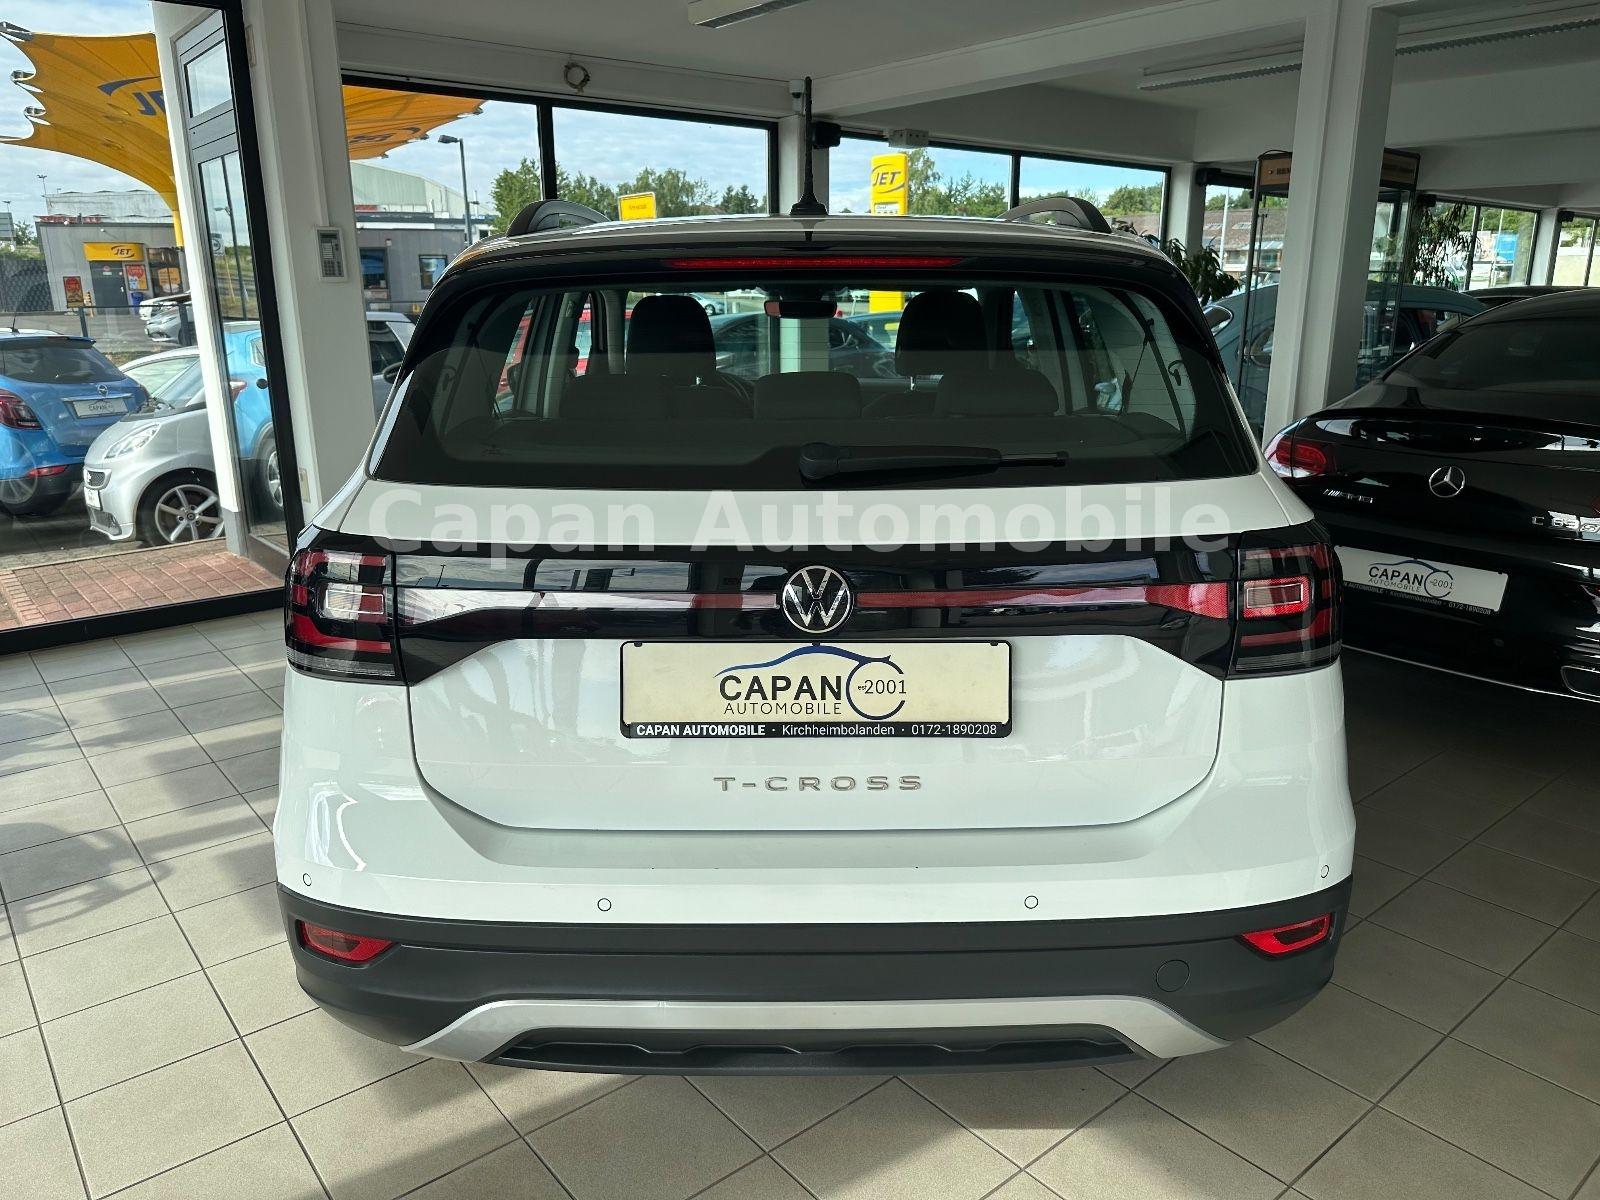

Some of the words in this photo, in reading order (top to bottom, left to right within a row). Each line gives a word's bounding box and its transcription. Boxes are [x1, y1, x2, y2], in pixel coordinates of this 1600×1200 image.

[872, 171, 902, 187] JET
[1368, 566, 1424, 587] CAPAN
[1368, 577, 1422, 593] AUTOMOBILE
[719, 675, 842, 701] CAPAN
[864, 679, 906, 695] 2001
[723, 702, 842, 715] AUTOMOBILE
[636, 724, 680, 736] CAPAN
[682, 724, 766, 736] AUTOMOBILE
[782, 724, 895, 736] Kirchheimbolanden
[911, 724, 997, 736] 0172-1890208
[713, 775, 922, 792] T-CROSS
